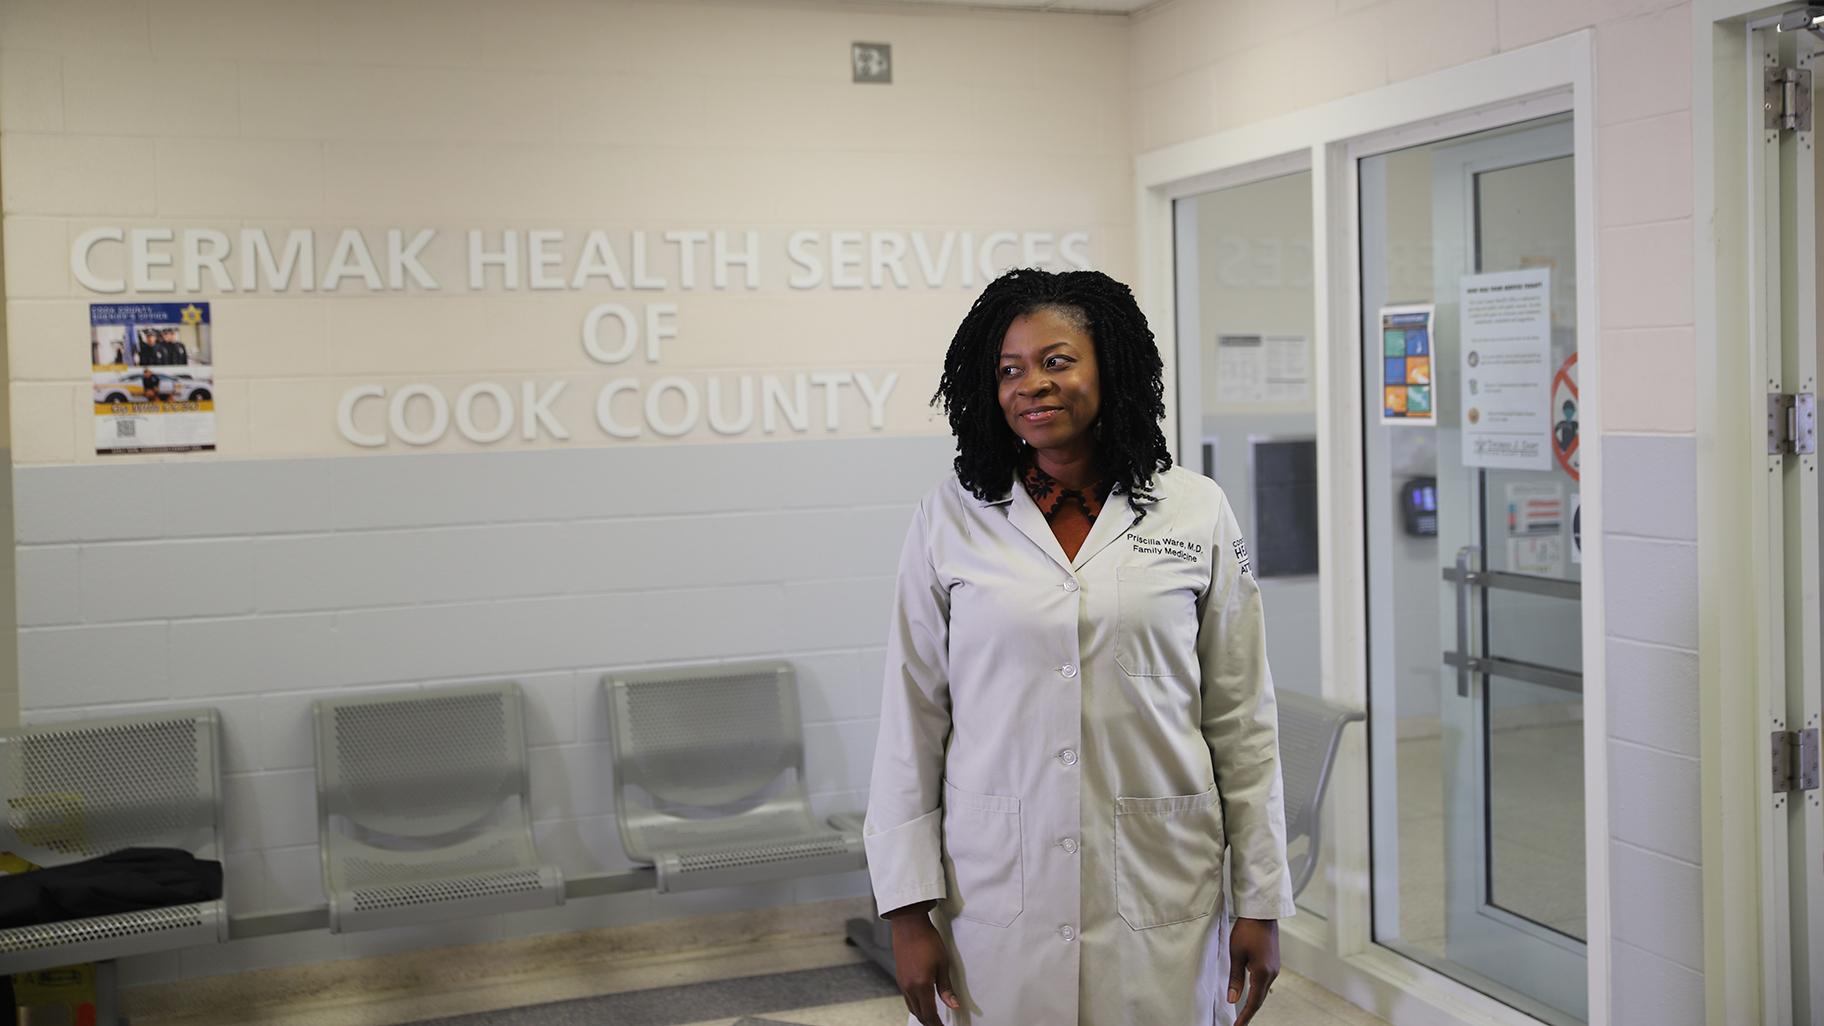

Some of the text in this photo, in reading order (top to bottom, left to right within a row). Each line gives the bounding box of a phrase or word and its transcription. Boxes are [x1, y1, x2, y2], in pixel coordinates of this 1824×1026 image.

[70, 227, 1091, 293] CERMAK HEALTH SERVICES
[582, 304, 679, 365] OF
[337, 372, 899, 447] COOK COUNTY
[1127, 533, 1204, 554] Priscilla Ware, M.D.
[1232, 537, 1243, 547] COO
[1235, 545, 1248, 559] HE
[1133, 544, 1198, 563] Family Medicine
